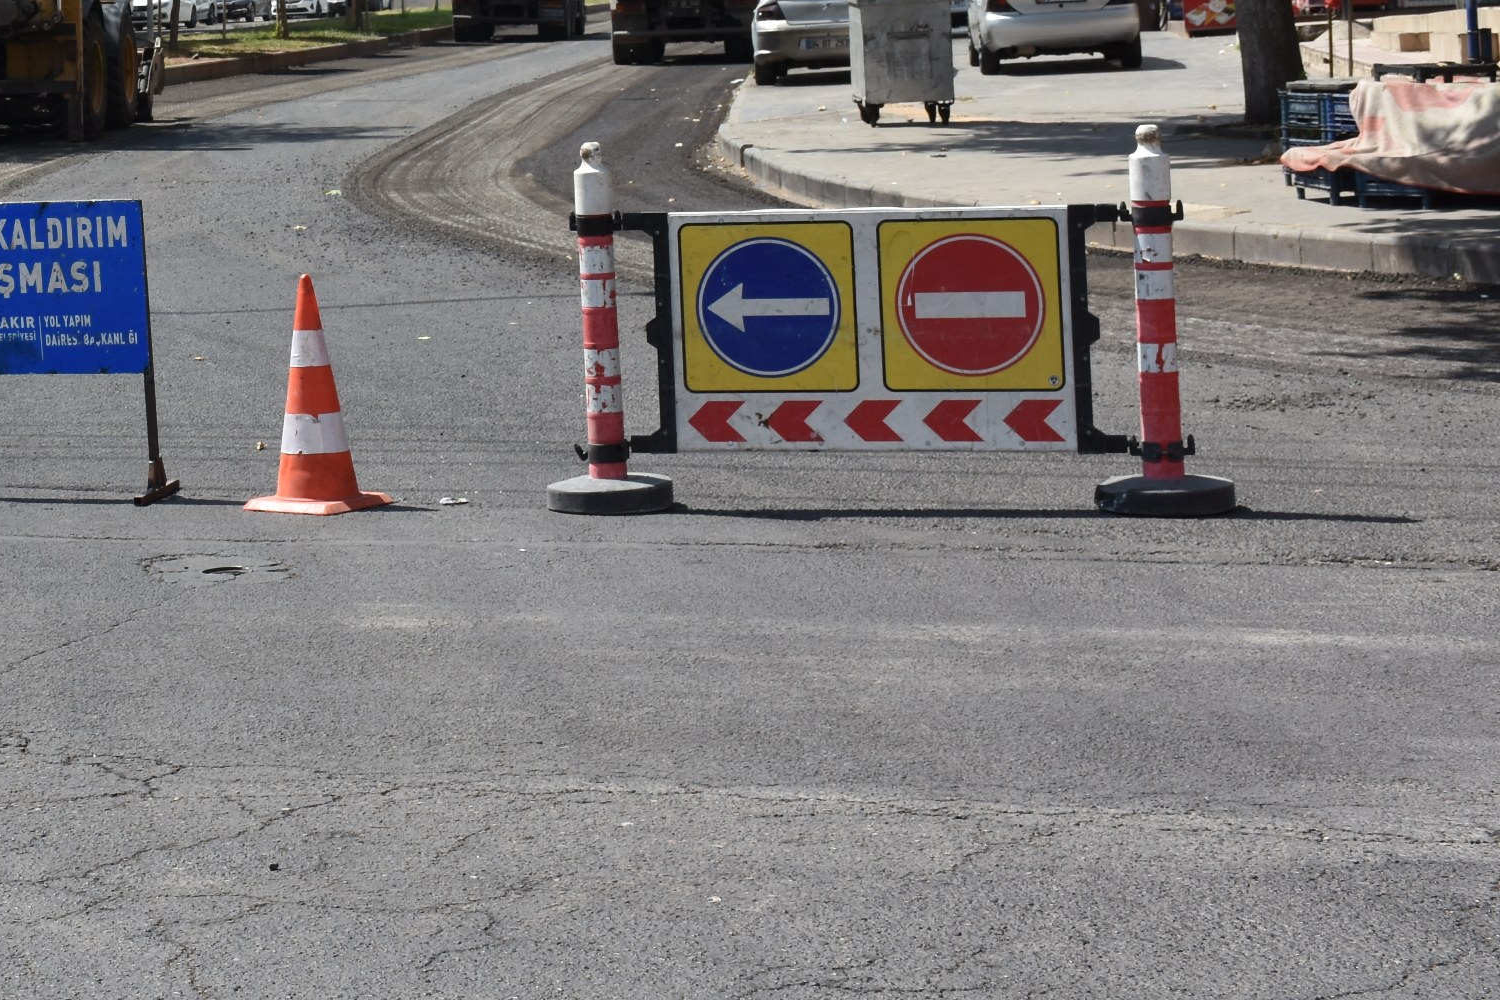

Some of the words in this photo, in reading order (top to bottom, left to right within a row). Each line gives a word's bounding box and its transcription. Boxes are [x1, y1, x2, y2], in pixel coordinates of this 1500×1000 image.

[43, 315, 60, 328] YOL
[63, 314, 92, 327] YAPIM
[45, 329, 81, 347] DAİRES
